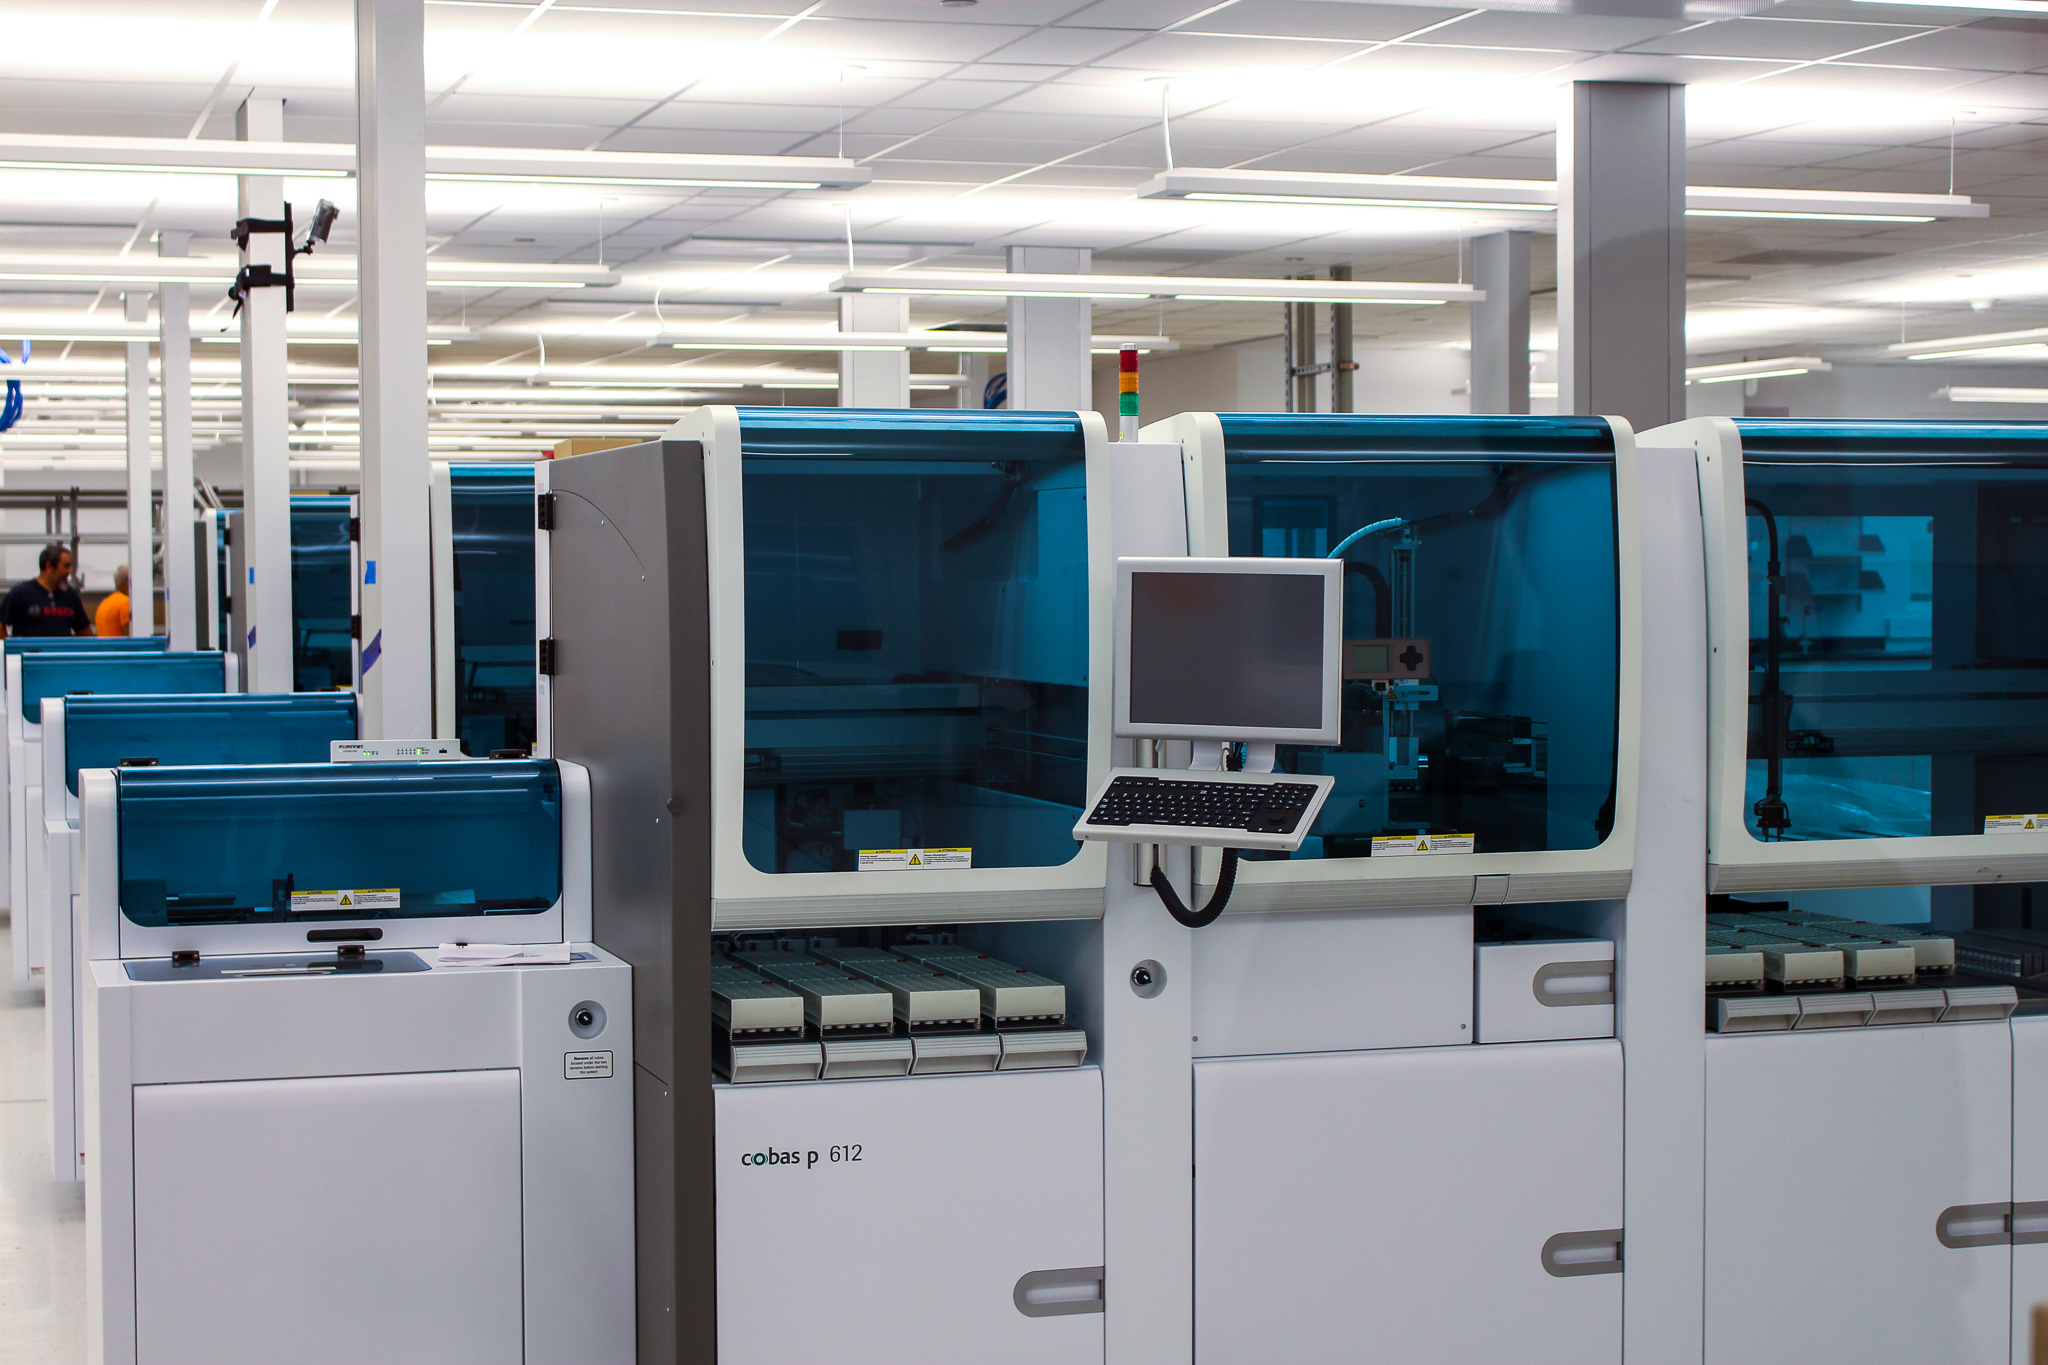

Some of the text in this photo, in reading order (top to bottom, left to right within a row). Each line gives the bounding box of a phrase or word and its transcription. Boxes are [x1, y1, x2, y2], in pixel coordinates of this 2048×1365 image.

[44, 606, 74, 616] BOSCH
[741, 1144, 863, 1169] cobas p 612
